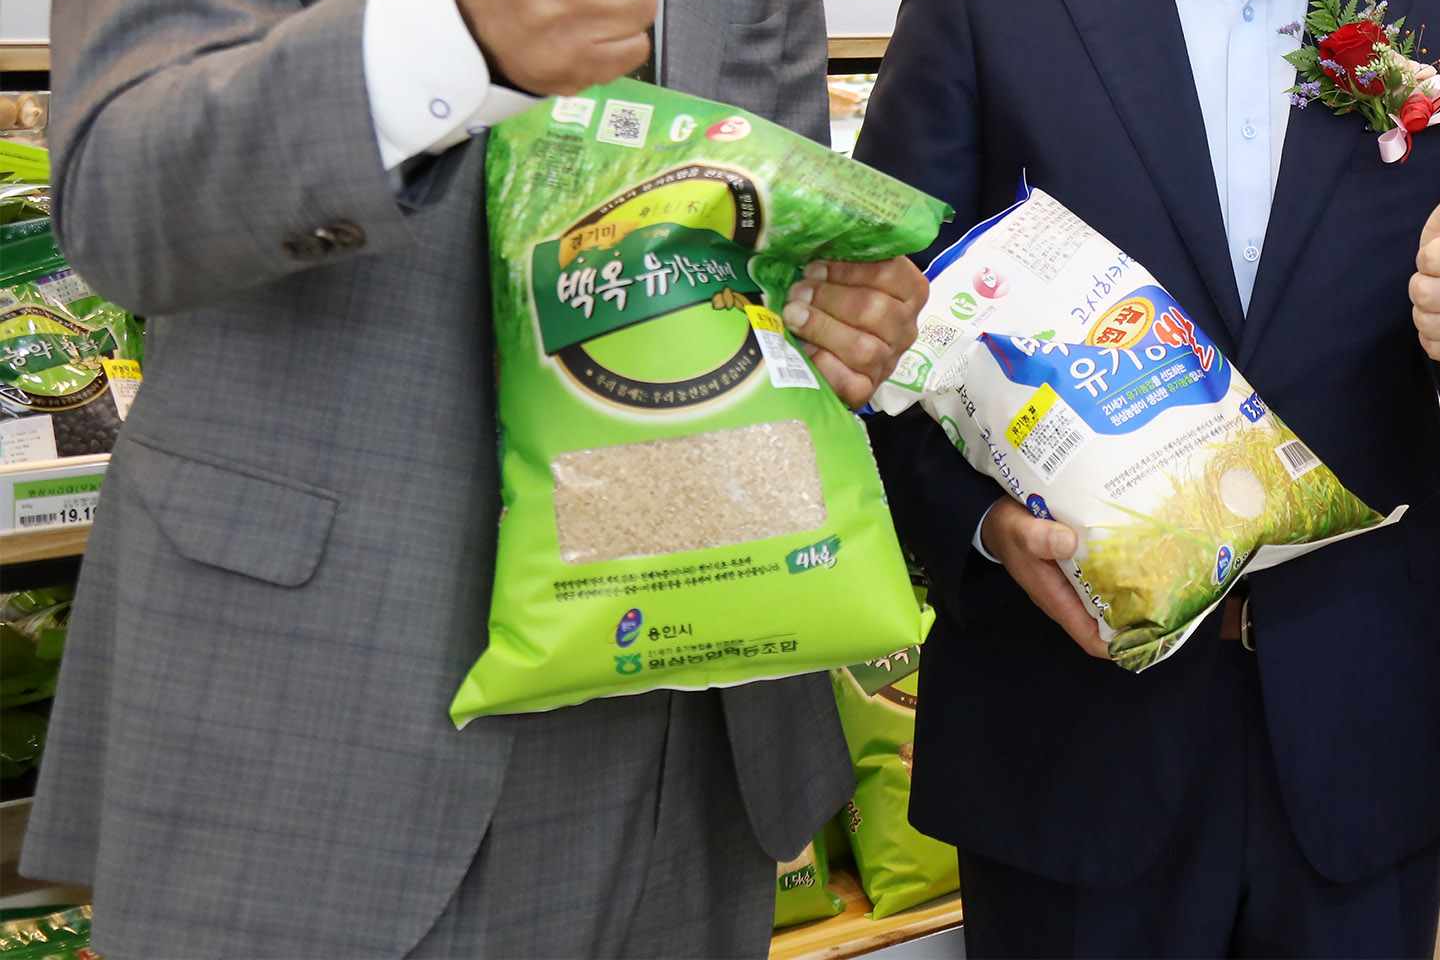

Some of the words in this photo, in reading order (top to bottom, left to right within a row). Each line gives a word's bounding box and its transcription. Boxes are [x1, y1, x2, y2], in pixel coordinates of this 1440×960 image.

[557, 250, 633, 319] 백옥
[1102, 395, 1127, 416] 21세기
[795, 544, 837, 569] 4kg
[648, 624, 693, 641] 용인시
[783, 870, 816, 888] 1.5kg
